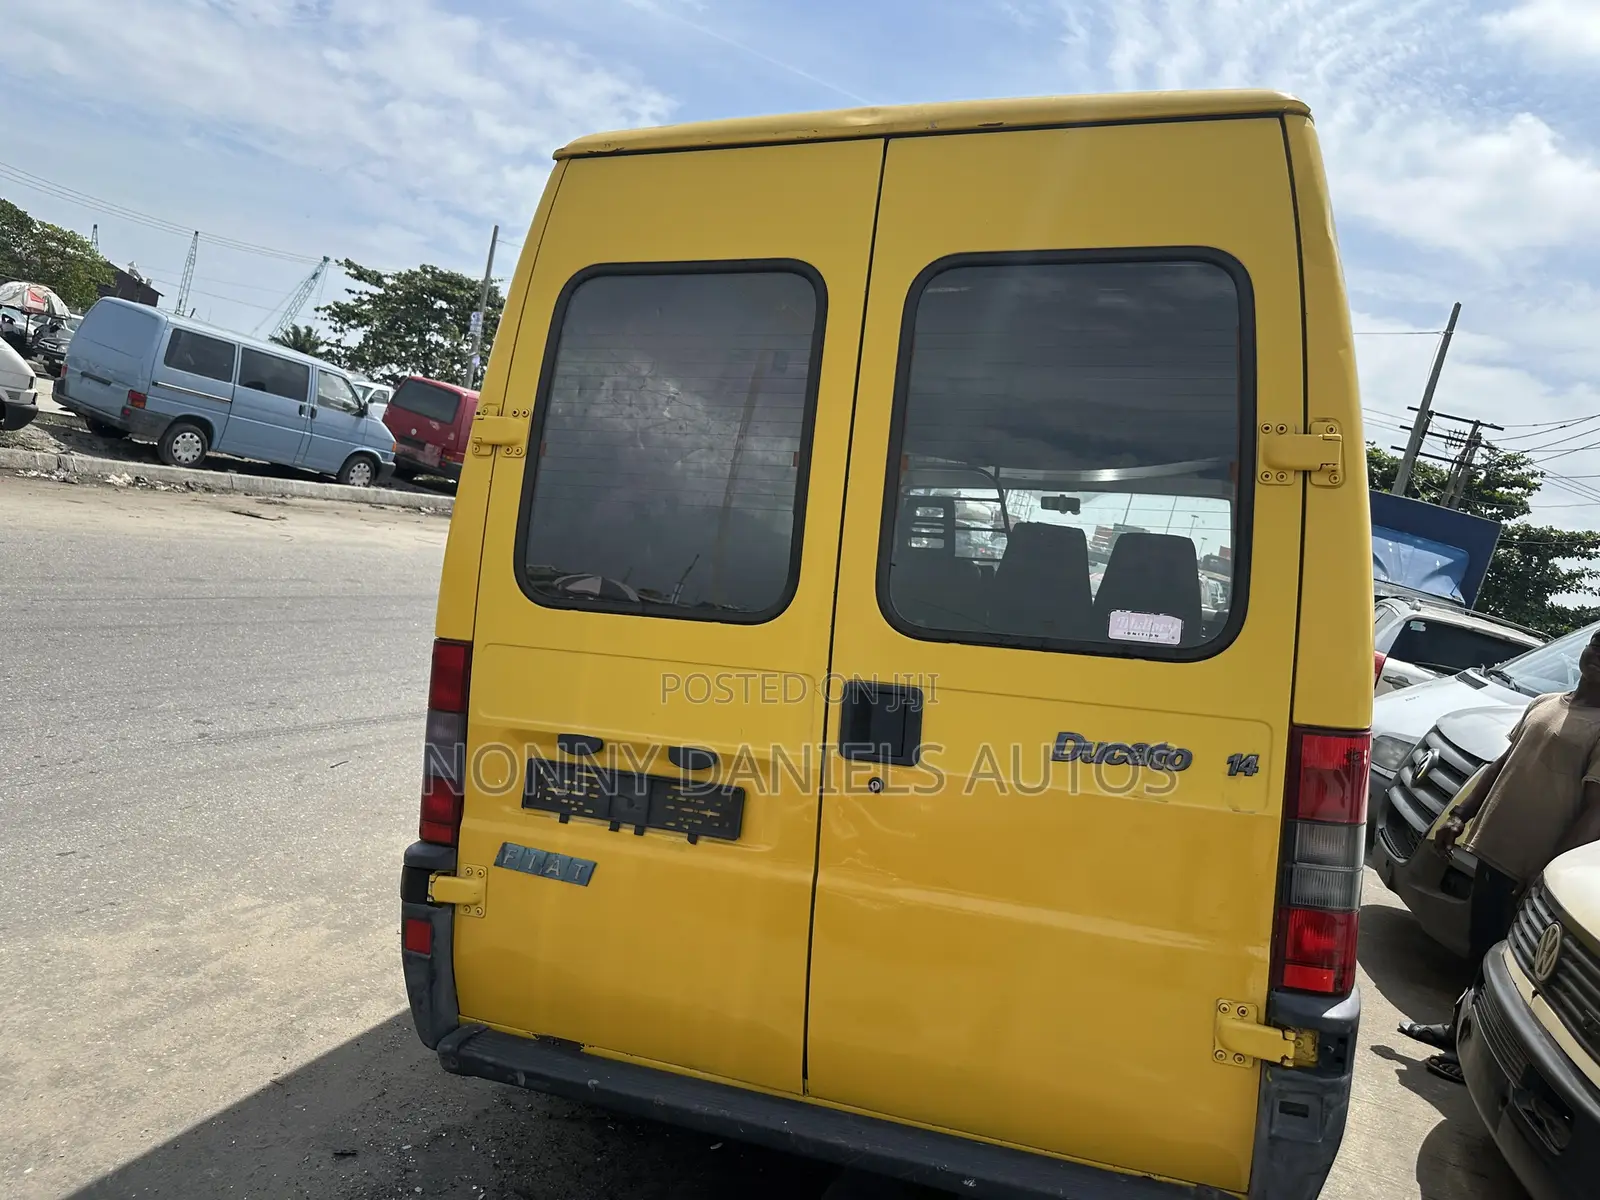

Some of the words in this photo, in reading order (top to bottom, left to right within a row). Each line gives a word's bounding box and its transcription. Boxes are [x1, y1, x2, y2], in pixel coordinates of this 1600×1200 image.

[1051, 731, 1193, 771] Ducato
[1227, 753, 1260, 776] 14
[502, 848, 590, 881] FIAT
